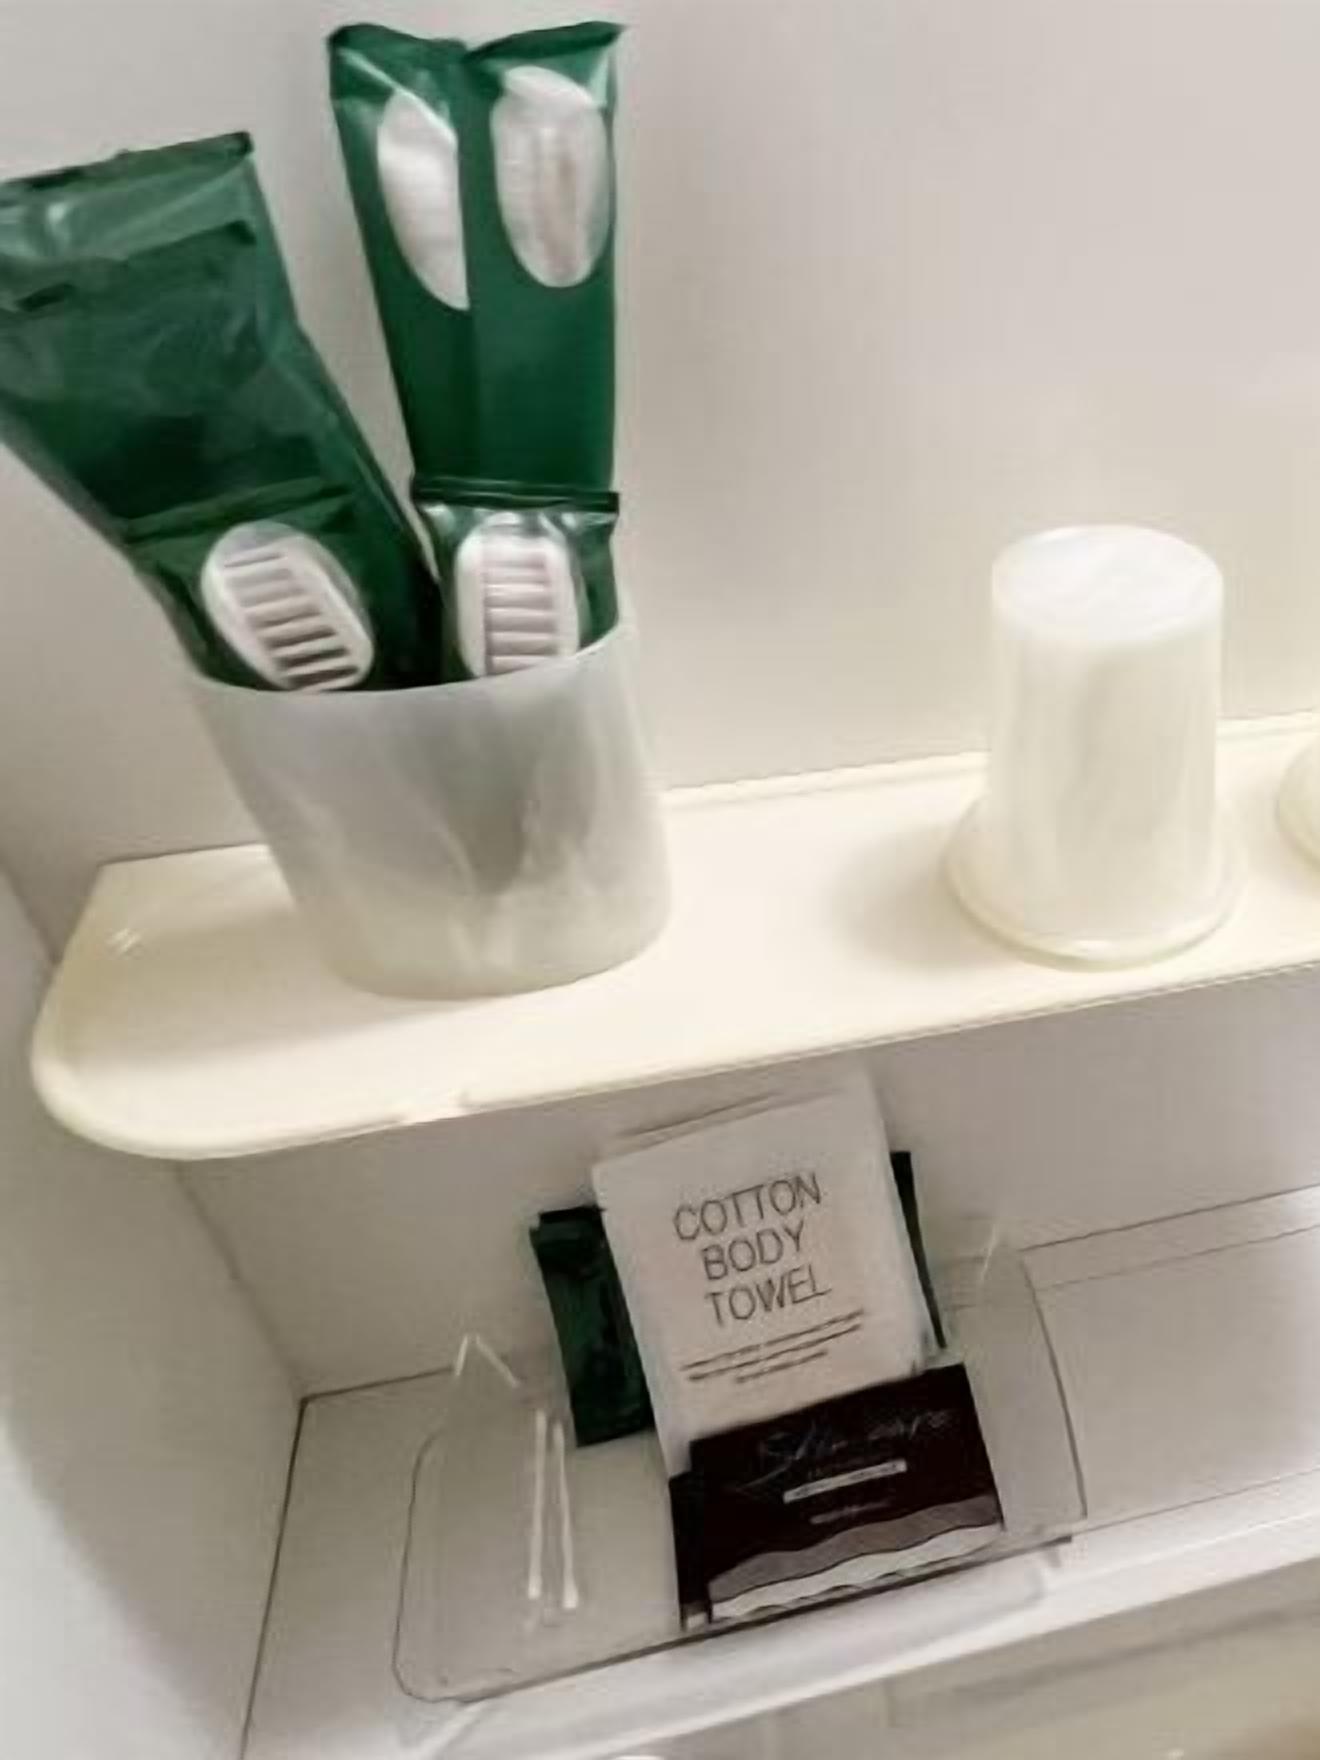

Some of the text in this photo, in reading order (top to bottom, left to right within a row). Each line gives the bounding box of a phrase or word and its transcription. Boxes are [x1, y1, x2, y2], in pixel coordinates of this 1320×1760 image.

[673, 1172, 821, 1241] COTTON
[702, 1220, 804, 1280] BODY
[704, 1264, 832, 1327] TOWEL
